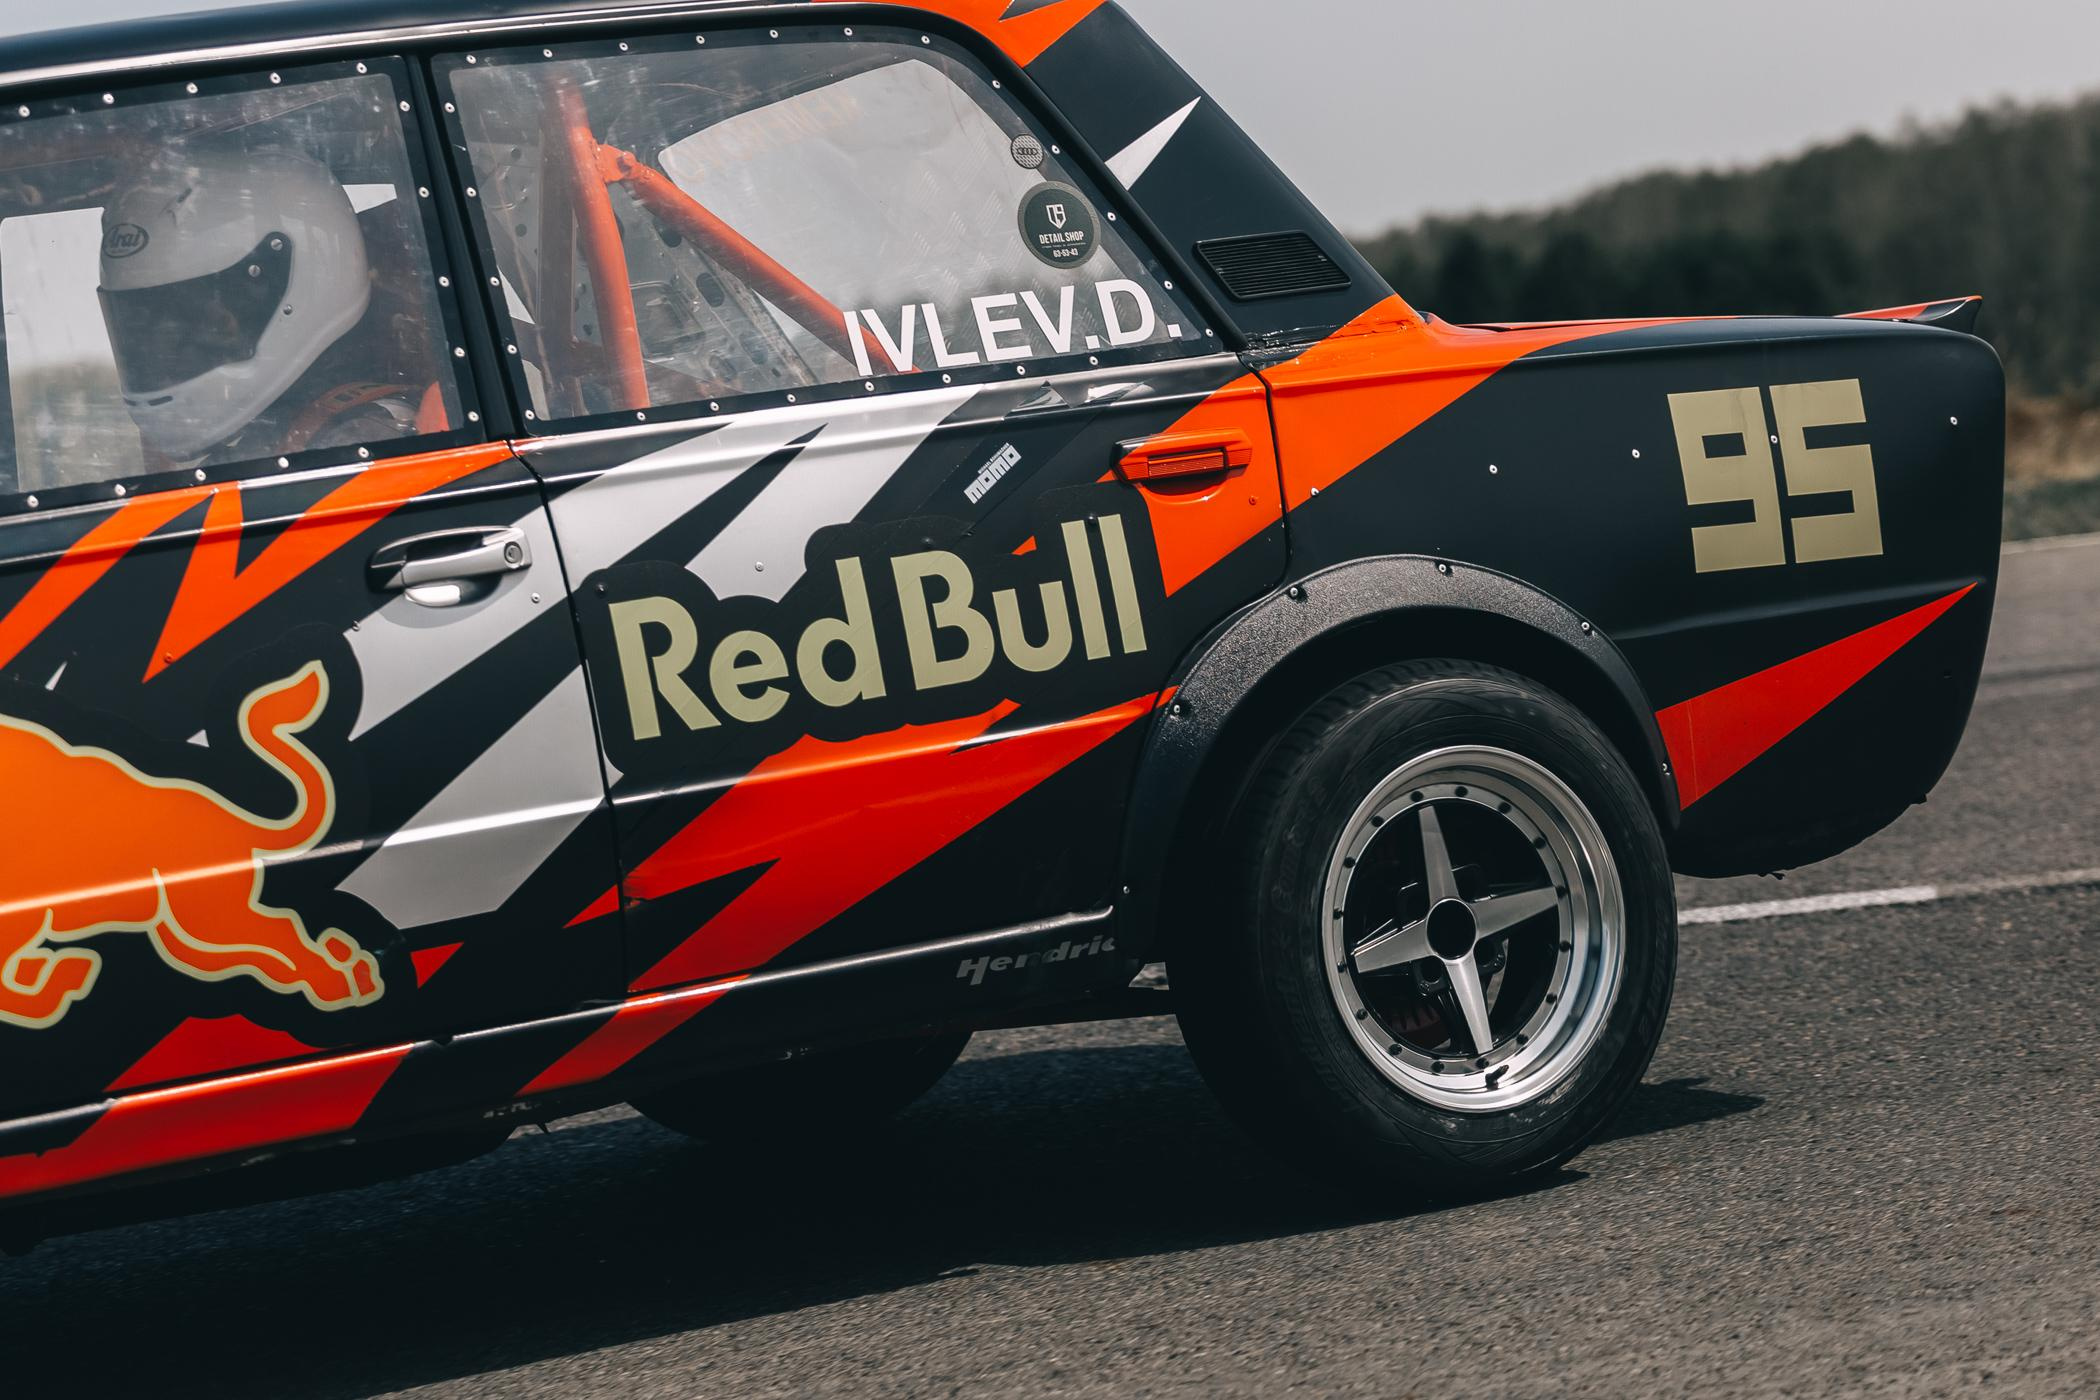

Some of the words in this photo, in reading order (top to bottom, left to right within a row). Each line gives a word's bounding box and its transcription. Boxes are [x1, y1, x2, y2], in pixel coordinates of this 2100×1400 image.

[1039, 232, 1065, 244] DETAIL
[1064, 231, 1084, 241] SHOP
[1053, 248, 1078, 258] 63-53-43
[1667, 378, 1883, 573] 95
[608, 557, 887, 741] Red
[890, 513, 1147, 691] Bull
